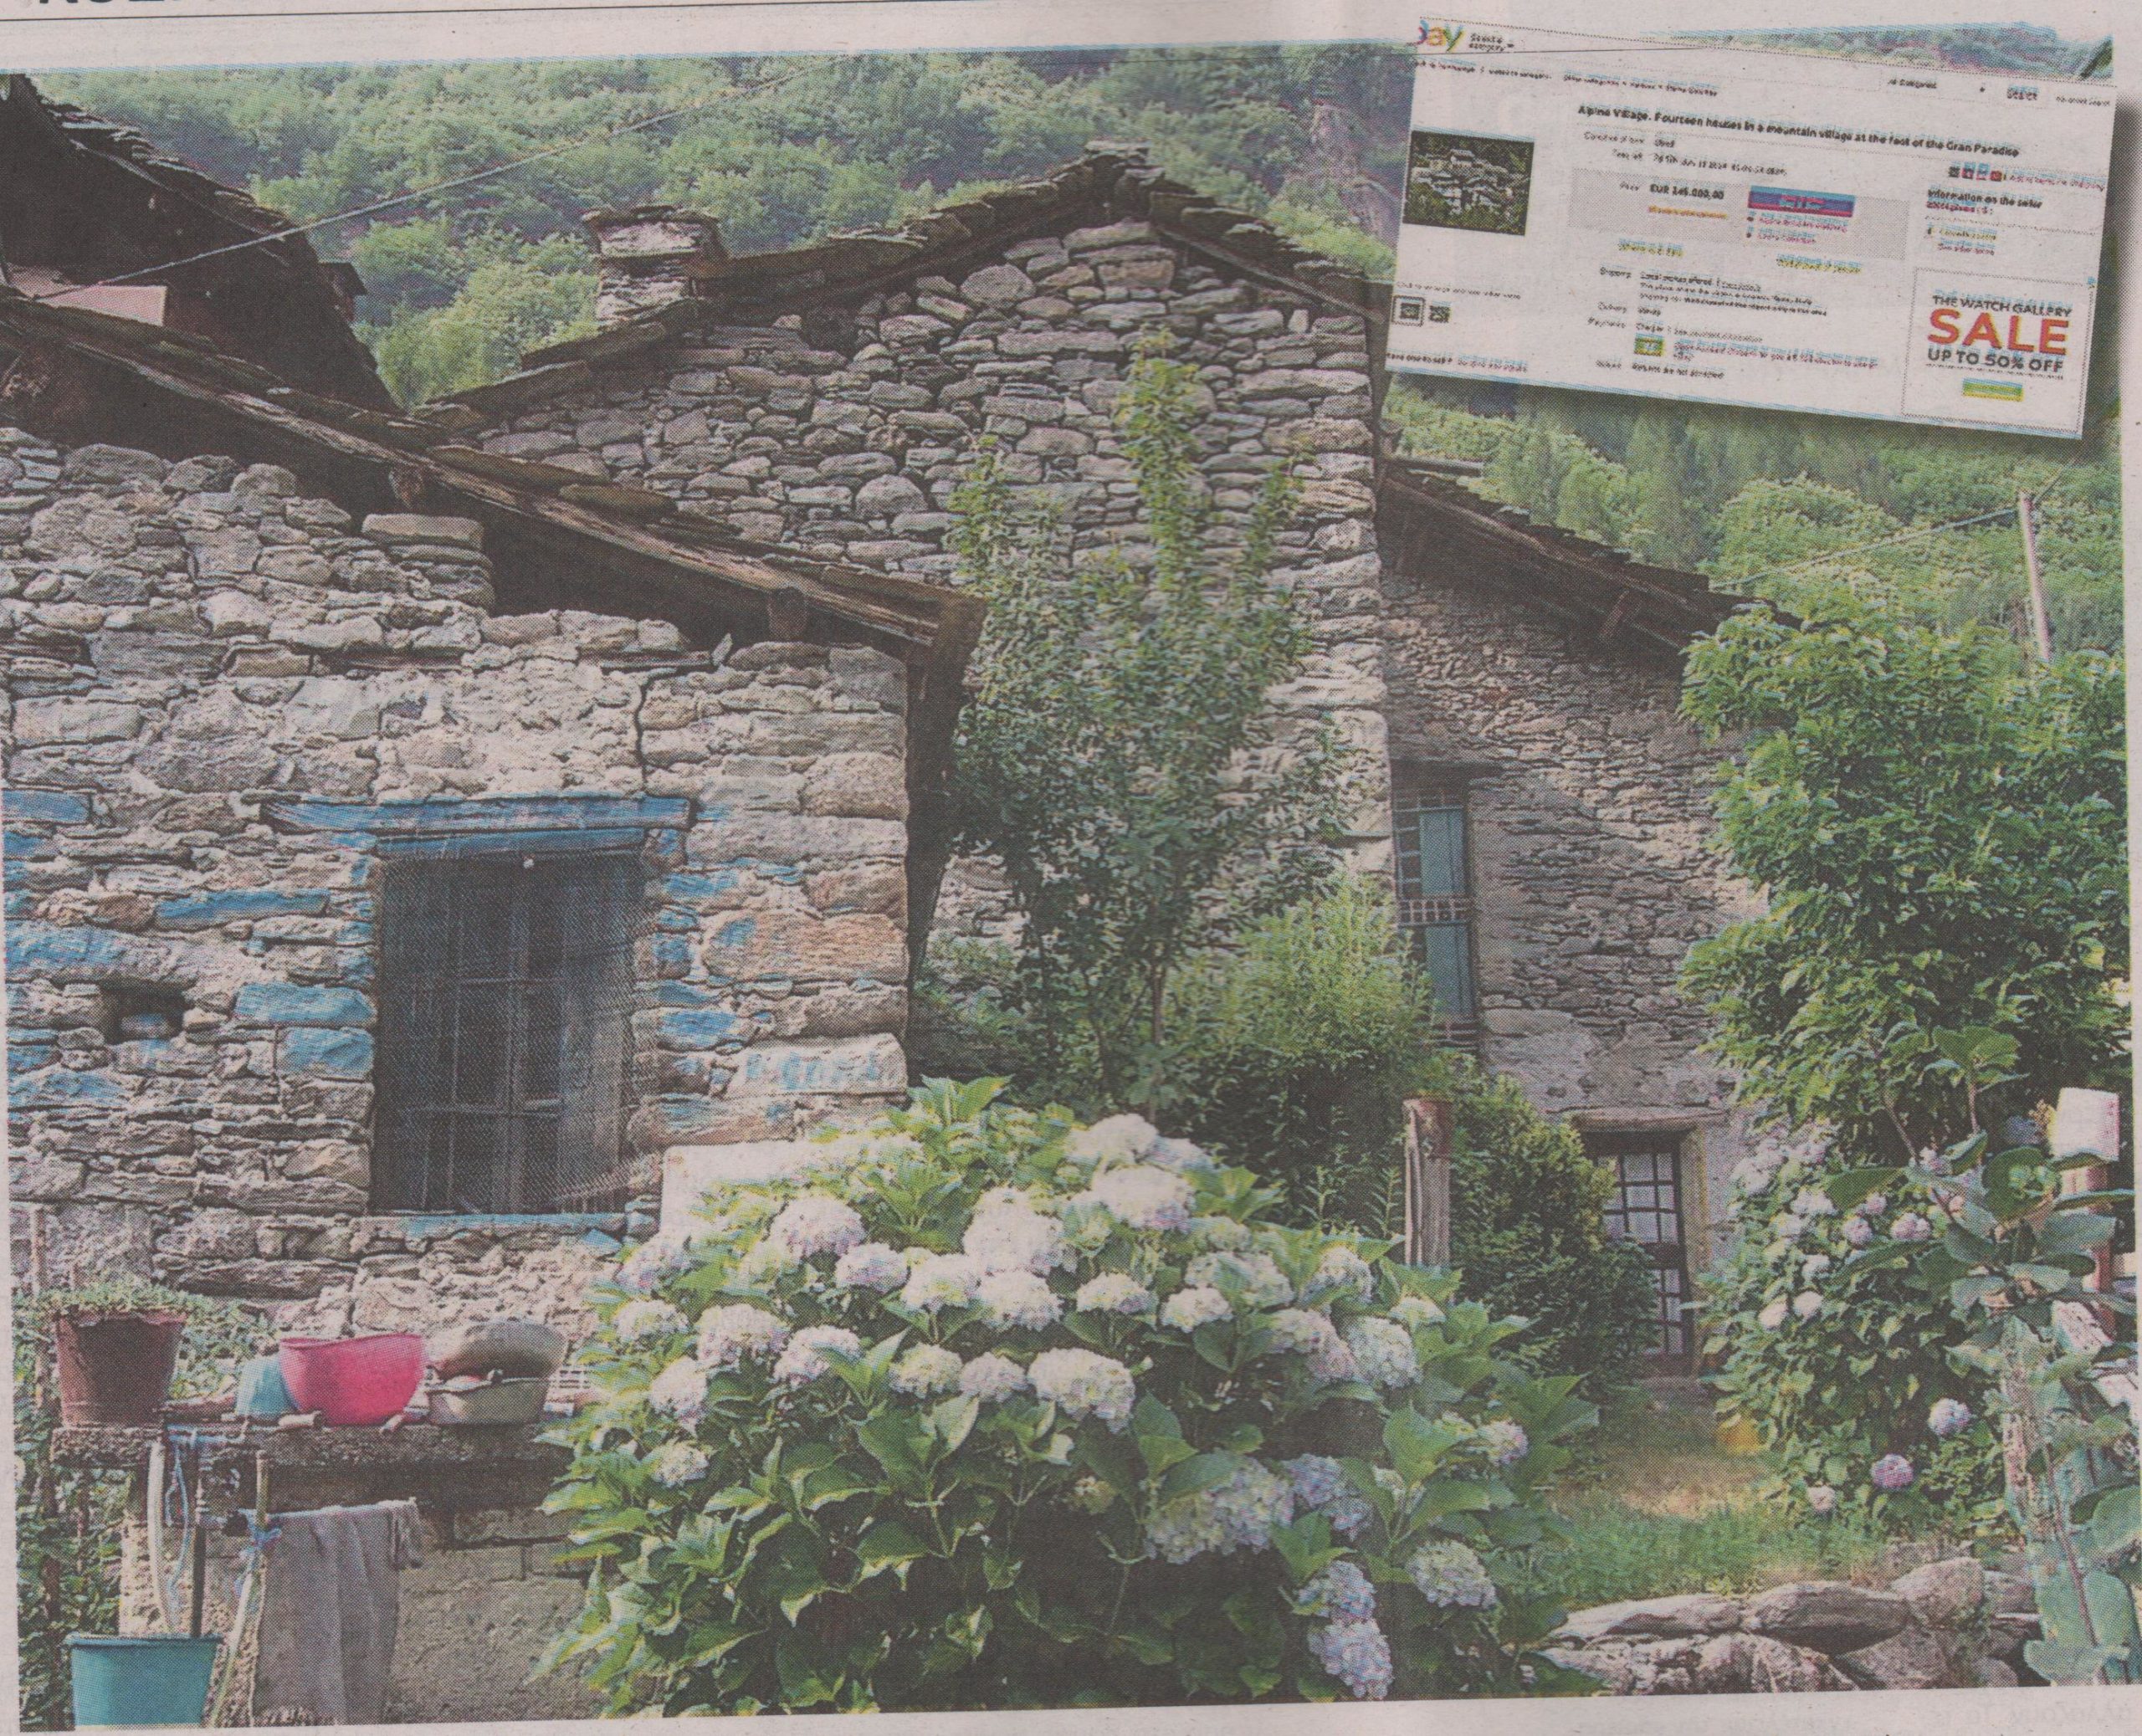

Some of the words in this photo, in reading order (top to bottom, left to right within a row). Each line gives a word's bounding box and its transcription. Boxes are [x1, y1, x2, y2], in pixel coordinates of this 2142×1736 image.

[1578, 105, 1611, 117] Alpine
[1654, 110, 1704, 125] Fourteen
[1706, 116, 1742, 131] houses
[1766, 125, 1817, 138] mountain
[1819, 126, 1852, 143] village
[1855, 132, 1867, 142] at
[1868, 133, 1887, 144] the
[1889, 135, 1910, 147] foot
[1912, 138, 1924, 148] of
[1926, 138, 1945, 150] the
[1946, 141, 1972, 152] Gran
[1974, 142, 2020, 158] Paradiso
[1650, 182, 1669, 197] EUR
[1932, 294, 1958, 307] THE
[1960, 297, 2009, 312] WATCH
[2012, 301, 2073, 317] GALLERY
[1927, 307, 2071, 356] SALE
[1928, 346, 1951, 361] UP
[1956, 349, 1979, 365] TO
[1985, 351, 2025, 370] 50%
[2029, 357, 2063, 373] OFF
